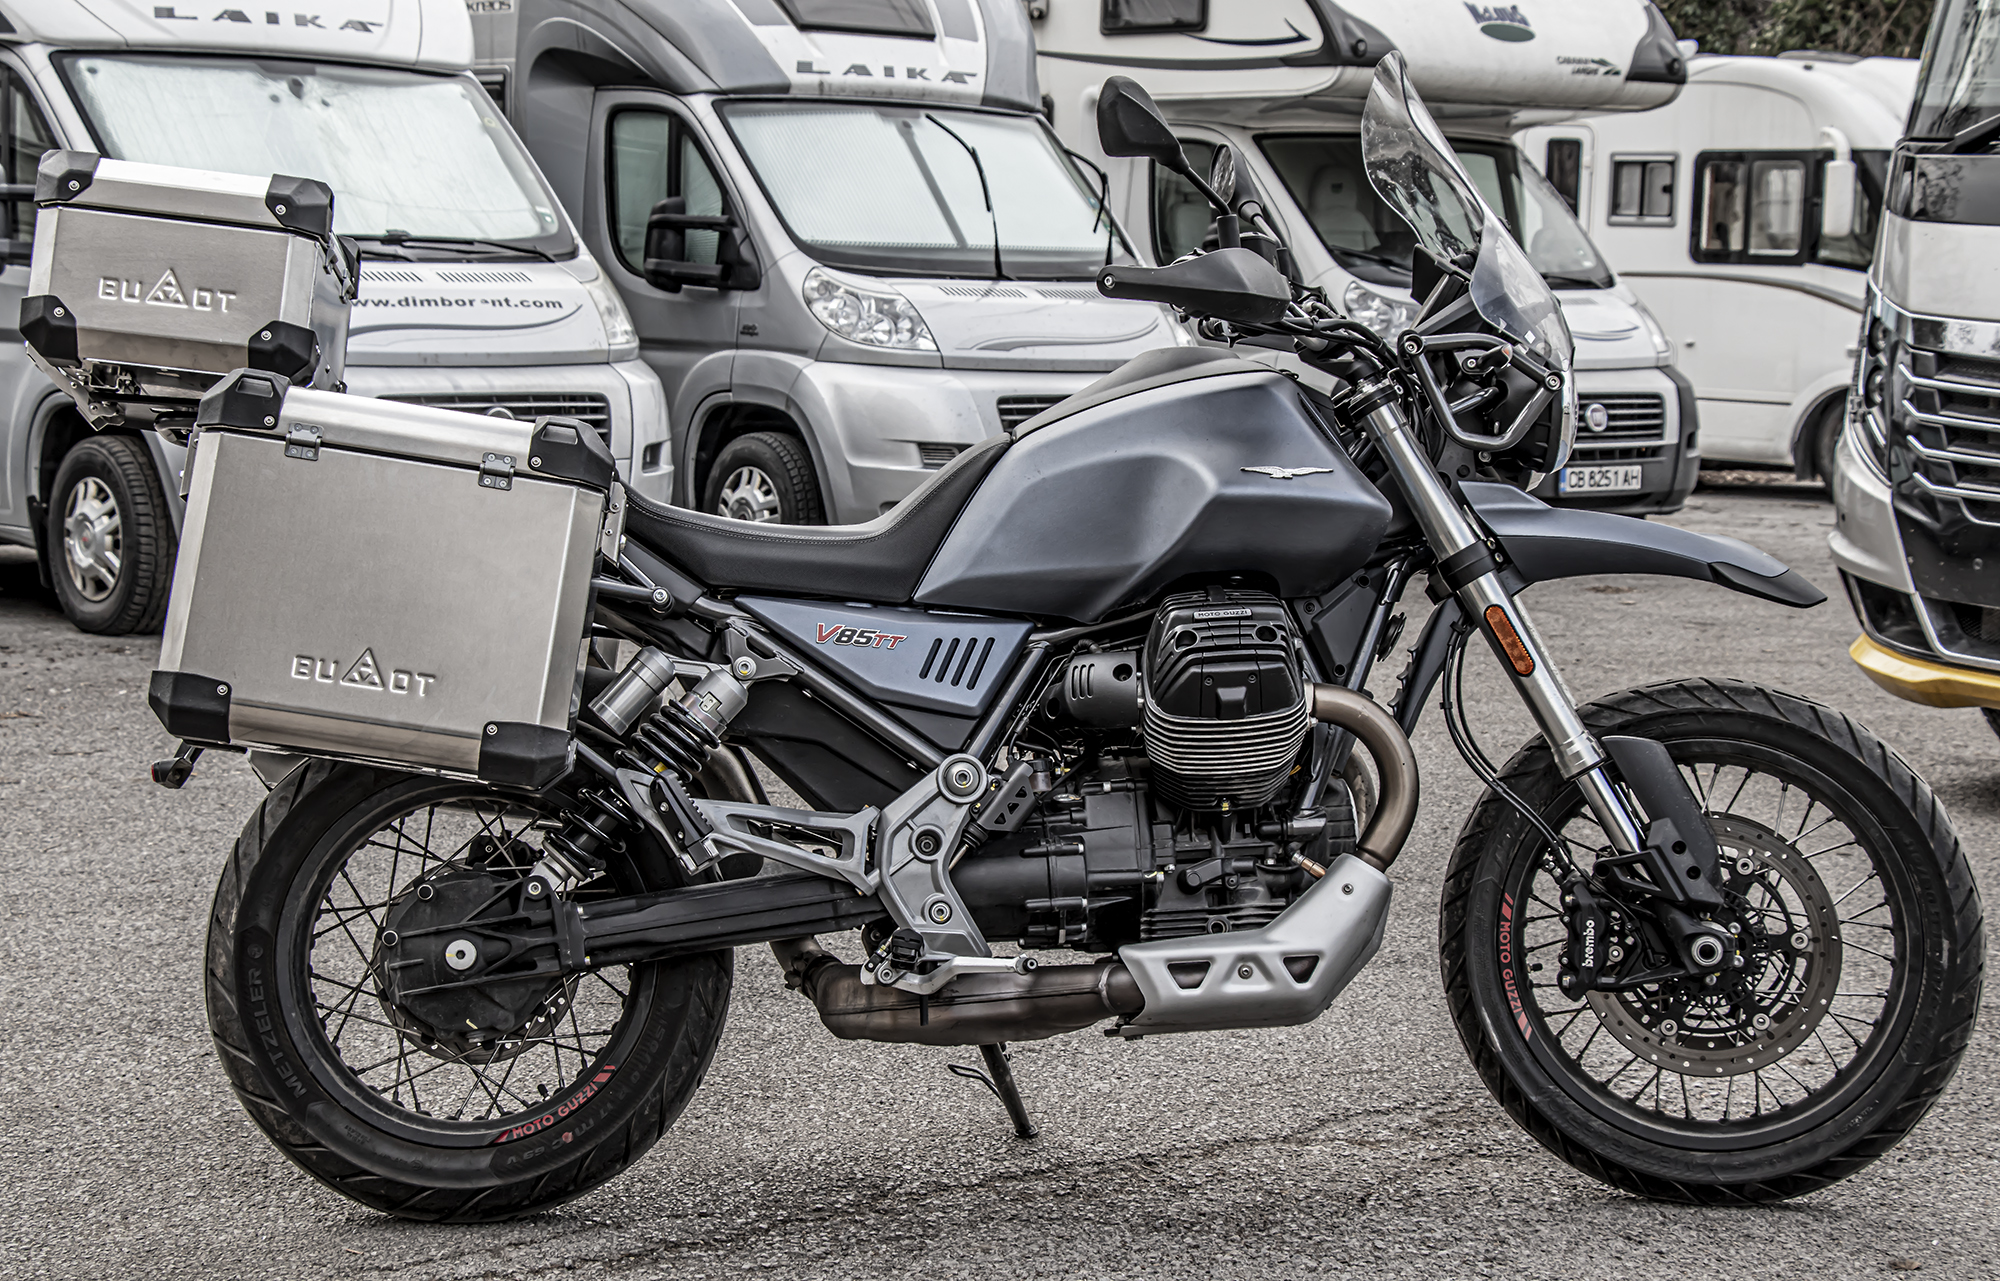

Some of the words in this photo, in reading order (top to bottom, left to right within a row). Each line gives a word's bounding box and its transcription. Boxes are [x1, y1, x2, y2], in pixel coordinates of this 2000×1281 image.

[153, 6, 384, 33] LAIKA
[797, 60, 978, 85] LAIKA
[1569, 470, 1585, 488] CB
[1589, 469, 1618, 487] 8251
[1623, 469, 1640, 486] AH
[816, 623, 908, 650] V85TT
[1500, 921, 1511, 963] MOTO
[1582, 919, 1595, 968] brembo
[1502, 968, 1523, 1014] GUZZI
[248, 967, 308, 1099] METZELER
[511, 1114, 554, 1139] MOTO
[558, 1082, 599, 1117] GUZZI
